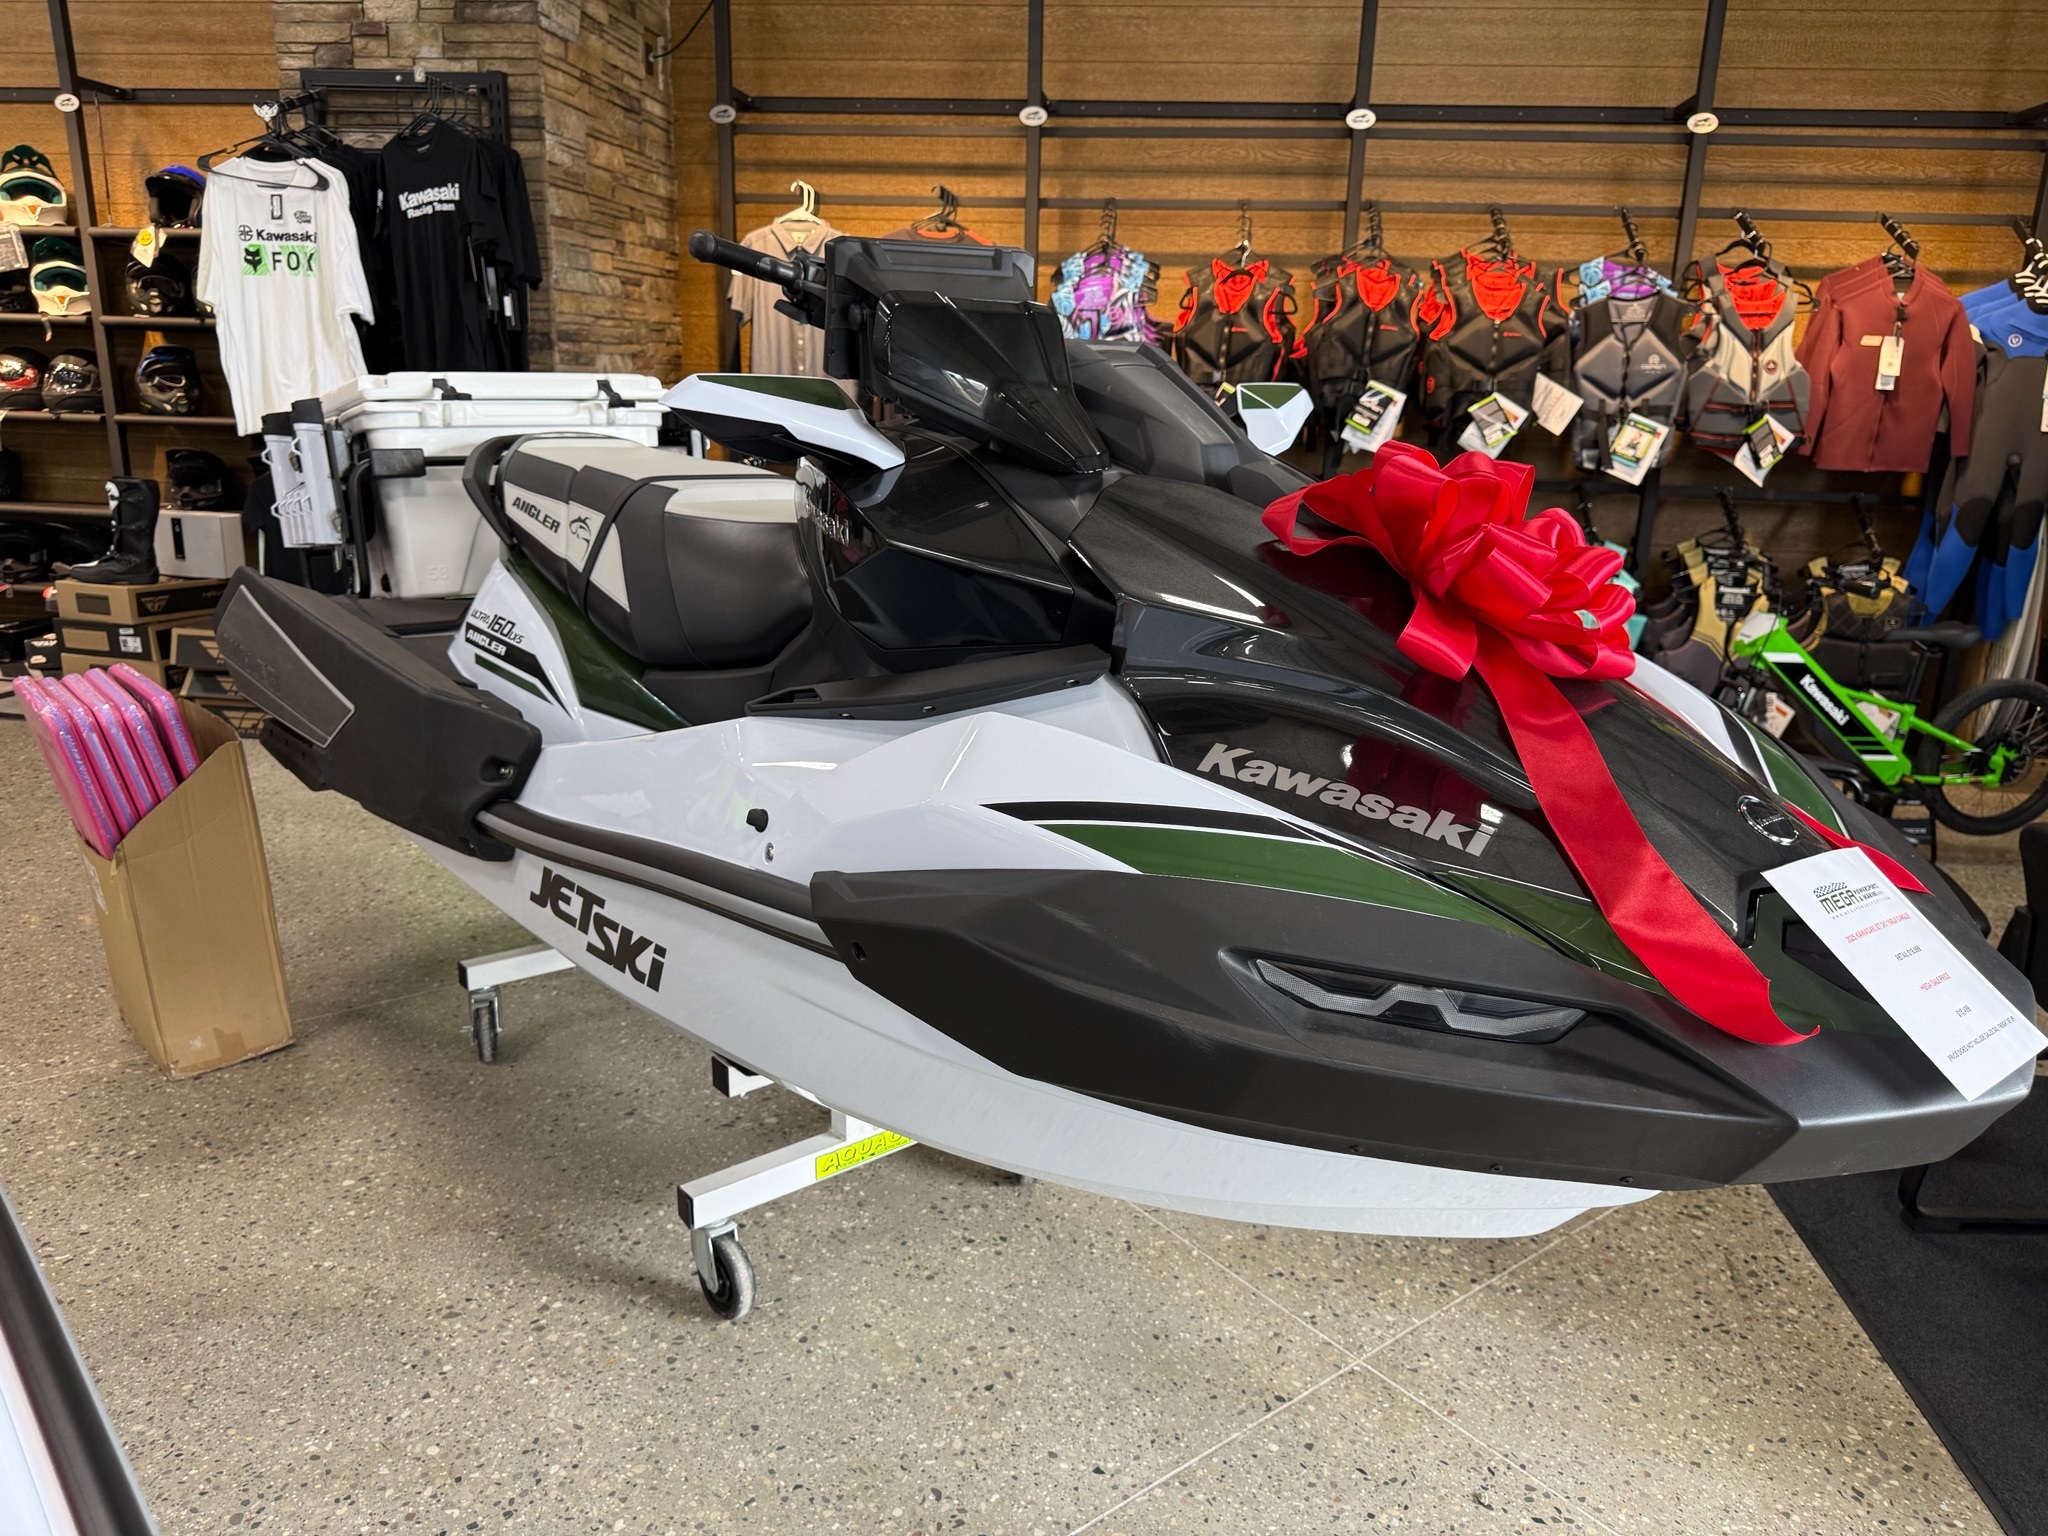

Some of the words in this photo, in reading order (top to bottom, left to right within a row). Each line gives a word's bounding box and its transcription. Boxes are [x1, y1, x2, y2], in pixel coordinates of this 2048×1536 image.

[398, 183, 460, 211] Kawasaki
[256, 228, 317, 243] Kawasaki
[512, 497, 561, 534] ANGLER
[466, 629, 507, 656] ANGLER
[1800, 674, 1850, 726] Kawasaki
[1197, 743, 1498, 857] Kawasaki
[1819, 889, 1858, 915] MEGA
[1855, 925, 1876, 939] KAWASAKI
[1920, 981, 1932, 992] MEGA
[1938, 972, 1951, 982] PRICE
